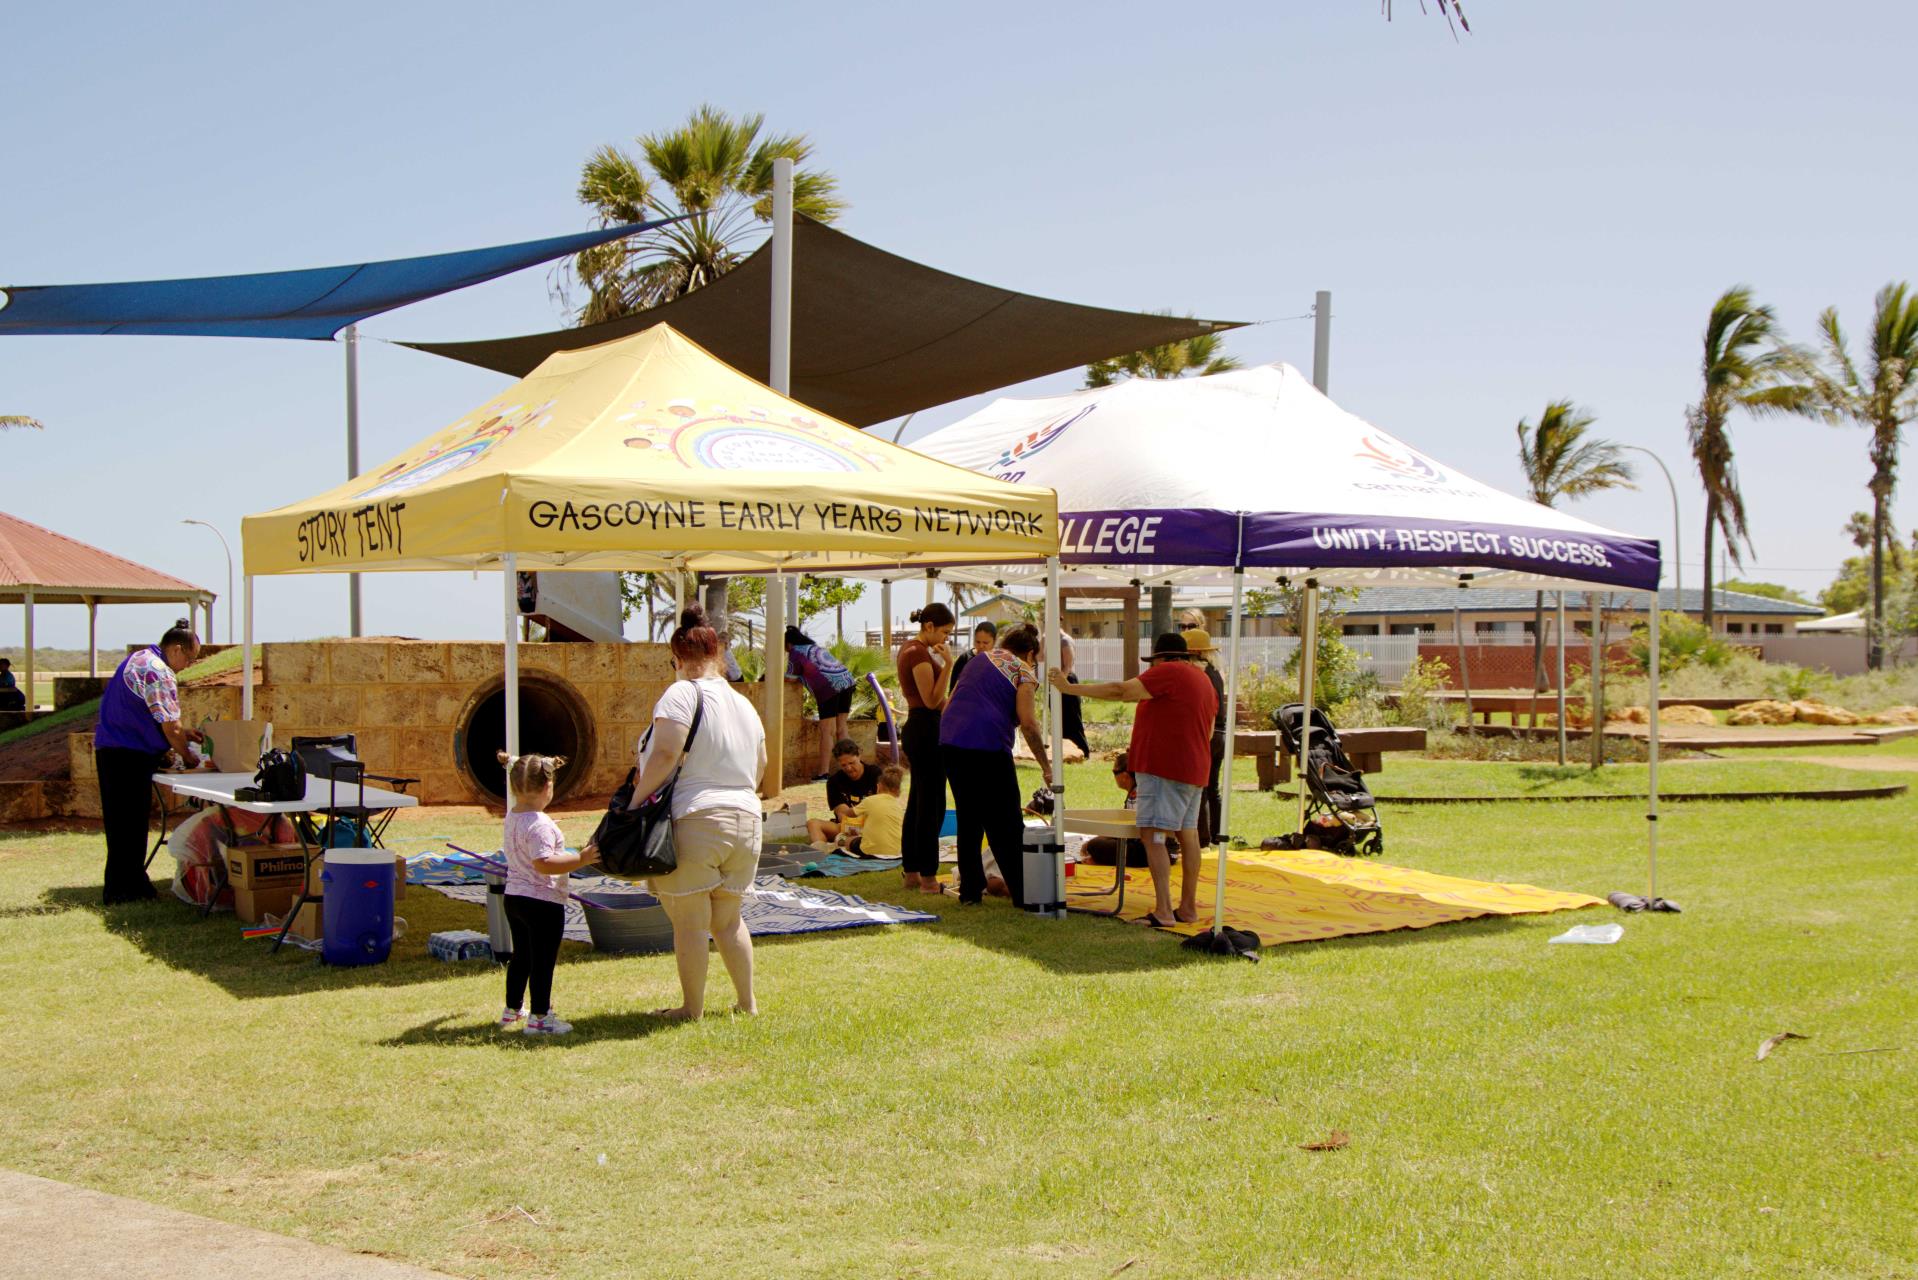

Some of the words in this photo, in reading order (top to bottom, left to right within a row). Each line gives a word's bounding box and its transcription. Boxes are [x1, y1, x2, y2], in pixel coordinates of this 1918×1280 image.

[297, 510, 347, 563] STORY
[352, 502, 406, 558] TENT
[528, 500, 706, 532] GASCOYNE
[718, 500, 805, 531] EARLY
[813, 502, 903, 533] YEARS
[914, 506, 1044, 537] NETWORK
[1311, 526, 1393, 552] UNITY.
[1398, 529, 1506, 556] RESPECT.
[1510, 535, 1613, 568] SUCCESS.
